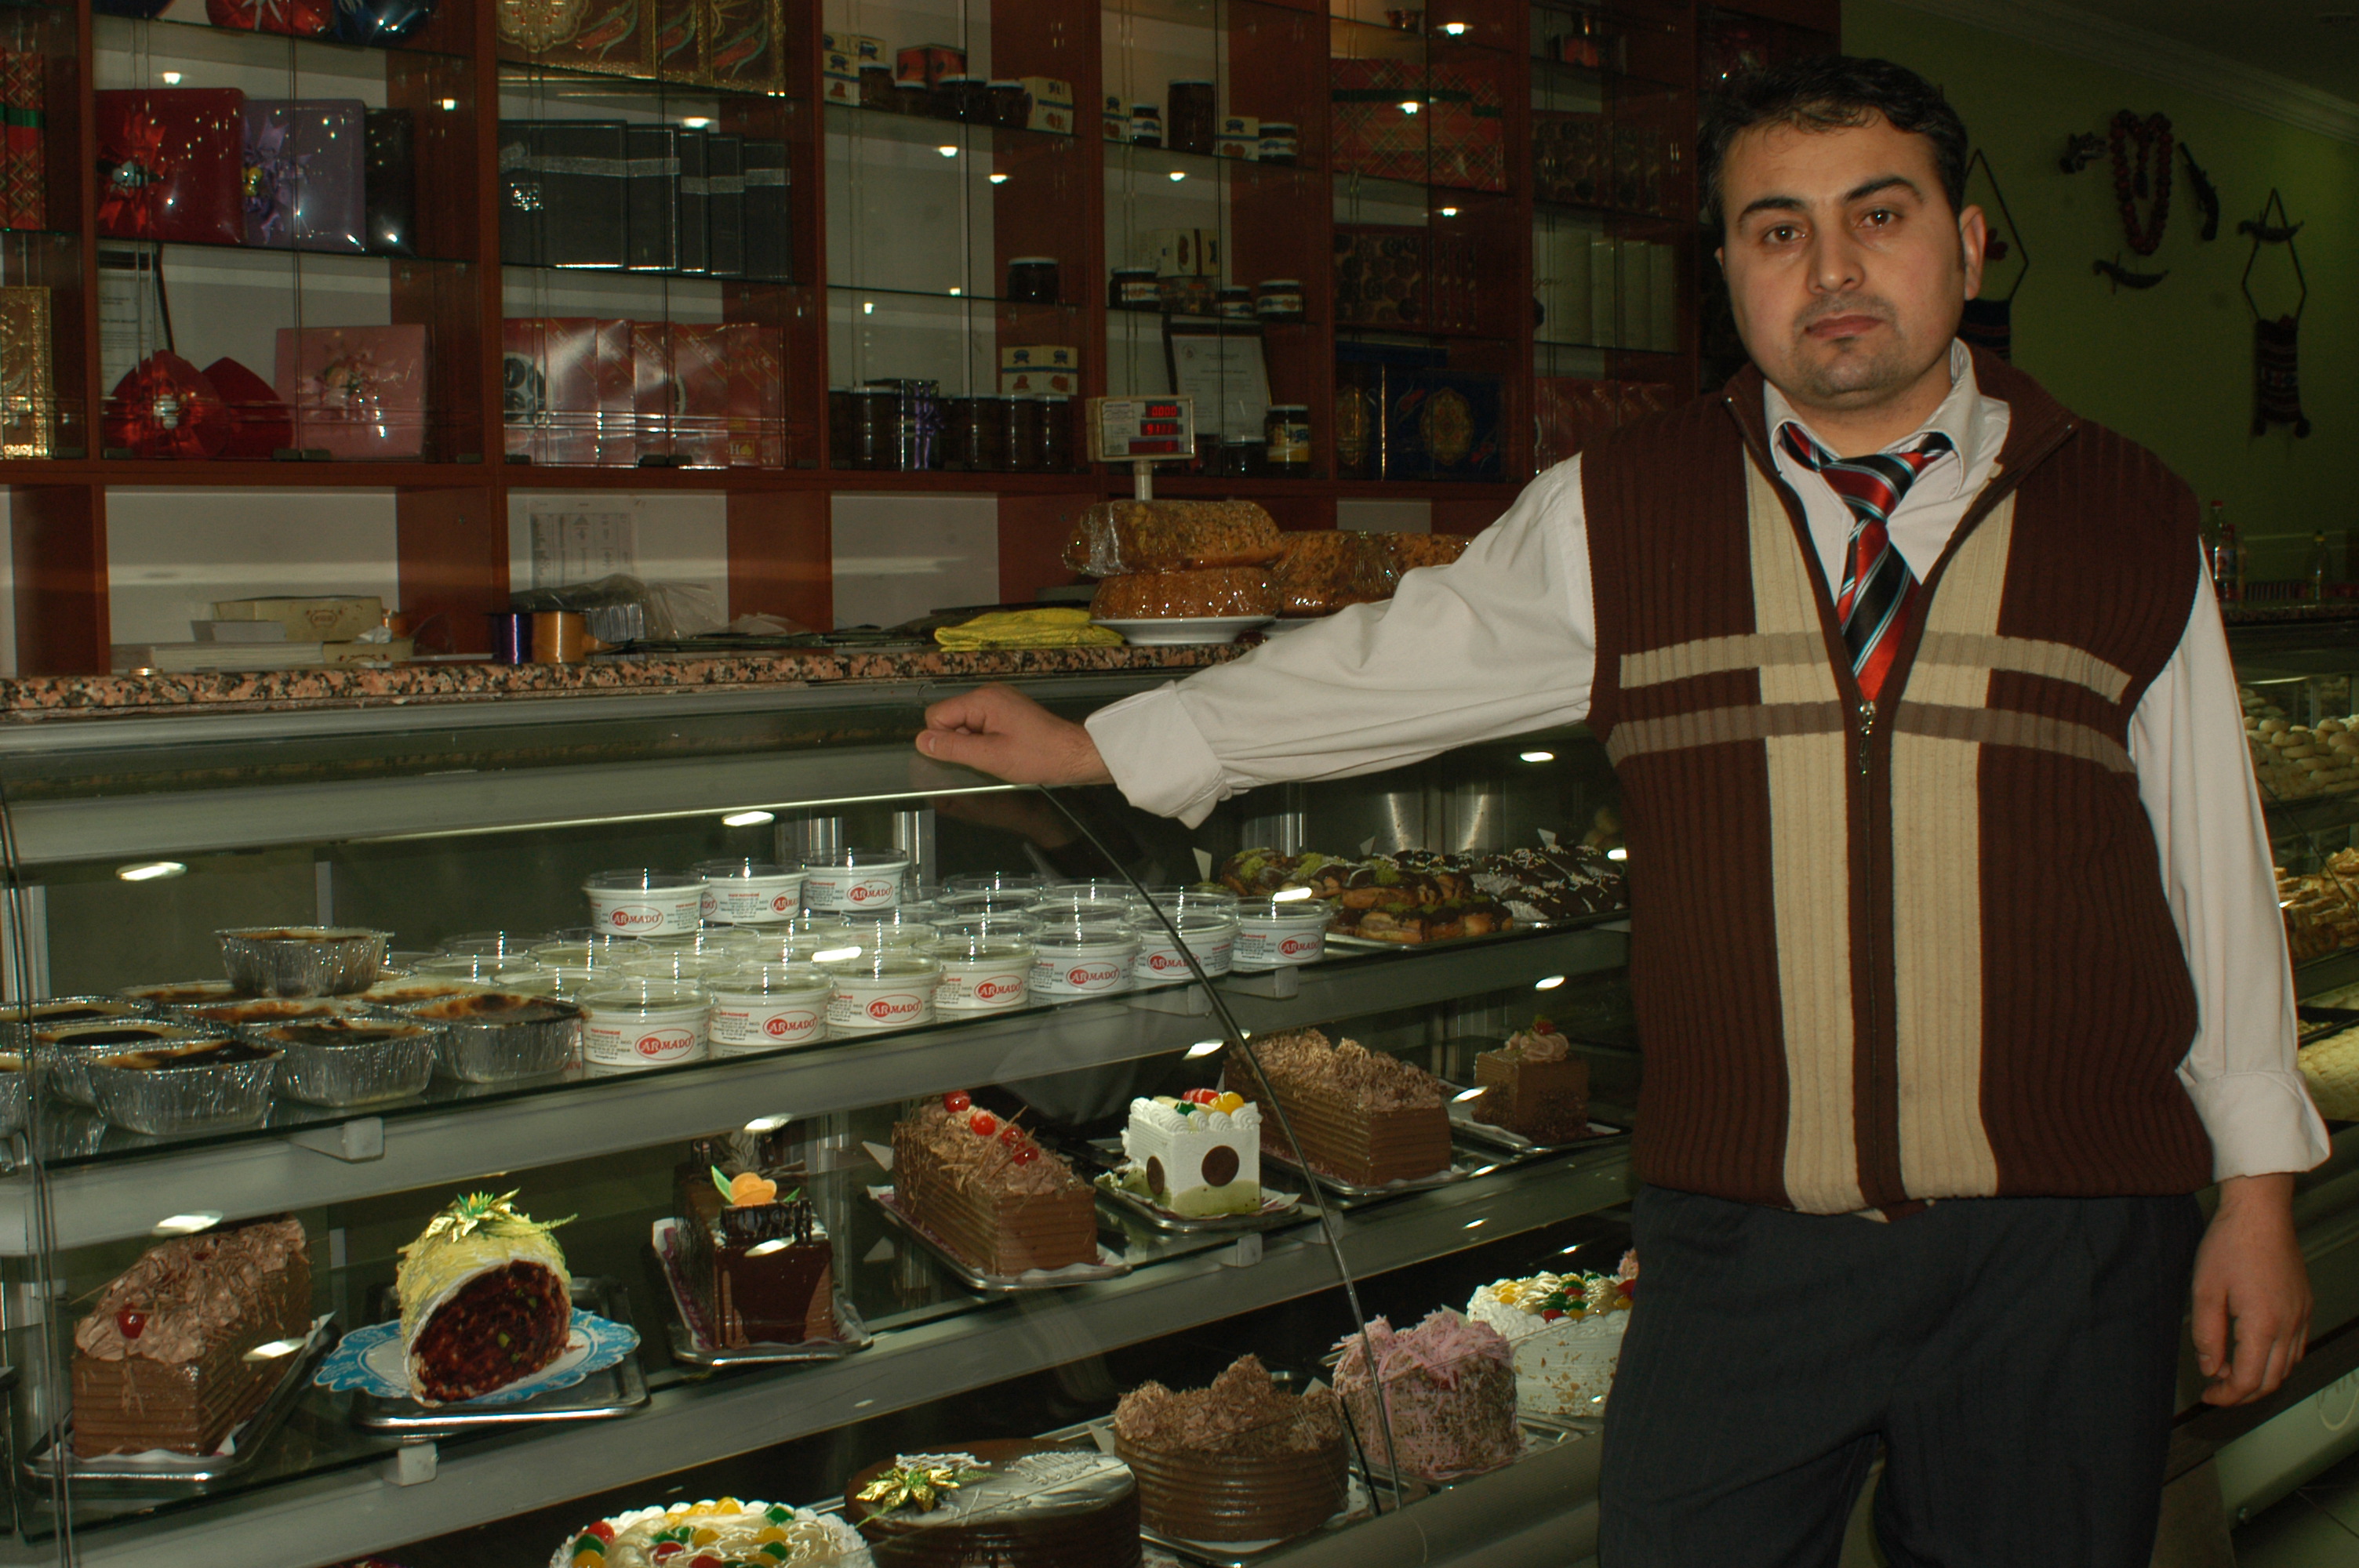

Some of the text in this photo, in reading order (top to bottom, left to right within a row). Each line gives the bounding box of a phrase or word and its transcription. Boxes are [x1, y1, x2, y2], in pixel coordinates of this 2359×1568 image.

[850, 886, 892, 901] ARMADO
[612, 912, 660, 925] ARMADO
[1281, 939, 1319, 954] ARMADO
[1150, 956, 1192, 970] ARMAD
[1070, 969, 1118, 984] ARMADO
[979, 982, 1022, 998] ARMADO
[871, 1001, 920, 1017] ARMADO
[768, 1018, 816, 1035] ARMADO
[640, 1036, 692, 1054] ARMADO
